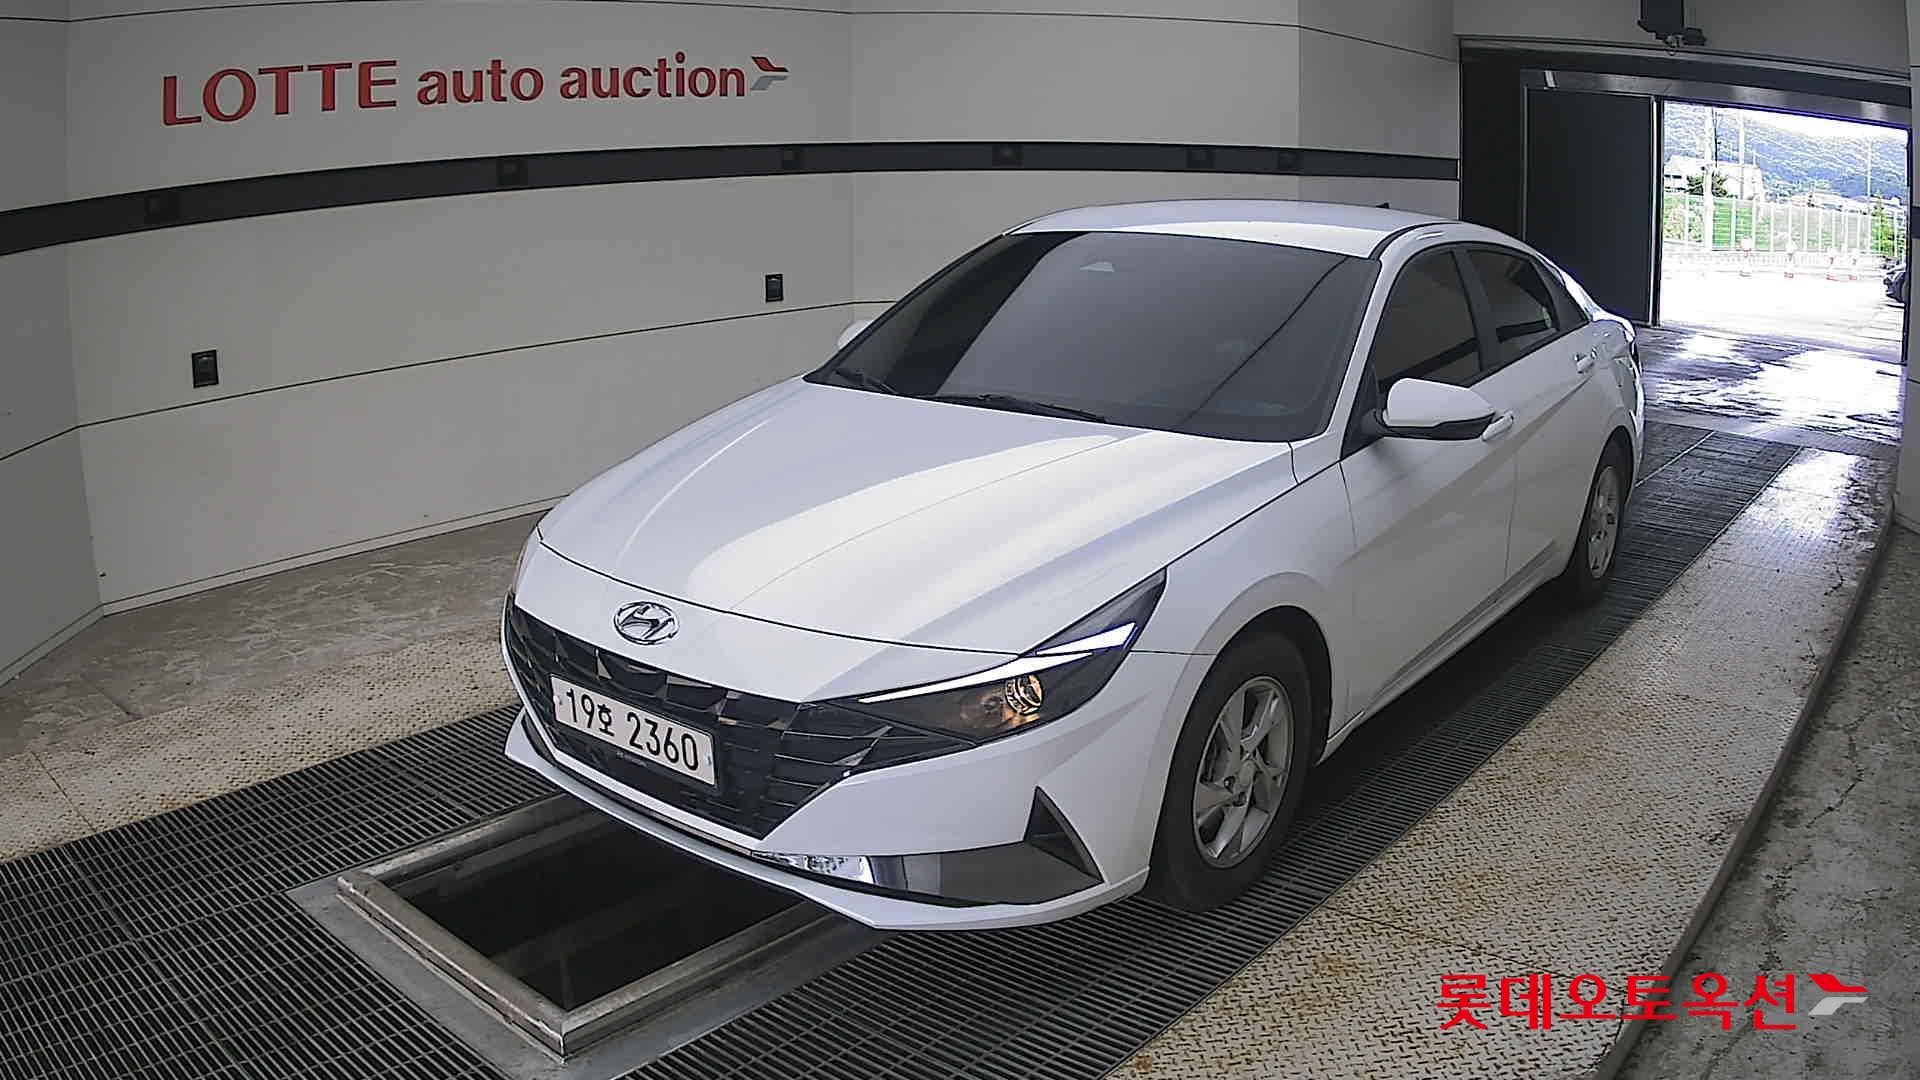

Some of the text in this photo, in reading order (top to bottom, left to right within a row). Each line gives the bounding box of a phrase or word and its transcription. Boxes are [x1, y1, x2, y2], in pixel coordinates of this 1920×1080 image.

[162, 51, 747, 126] LOTTE auto auction
[567, 688, 699, 771] 19호 2360
